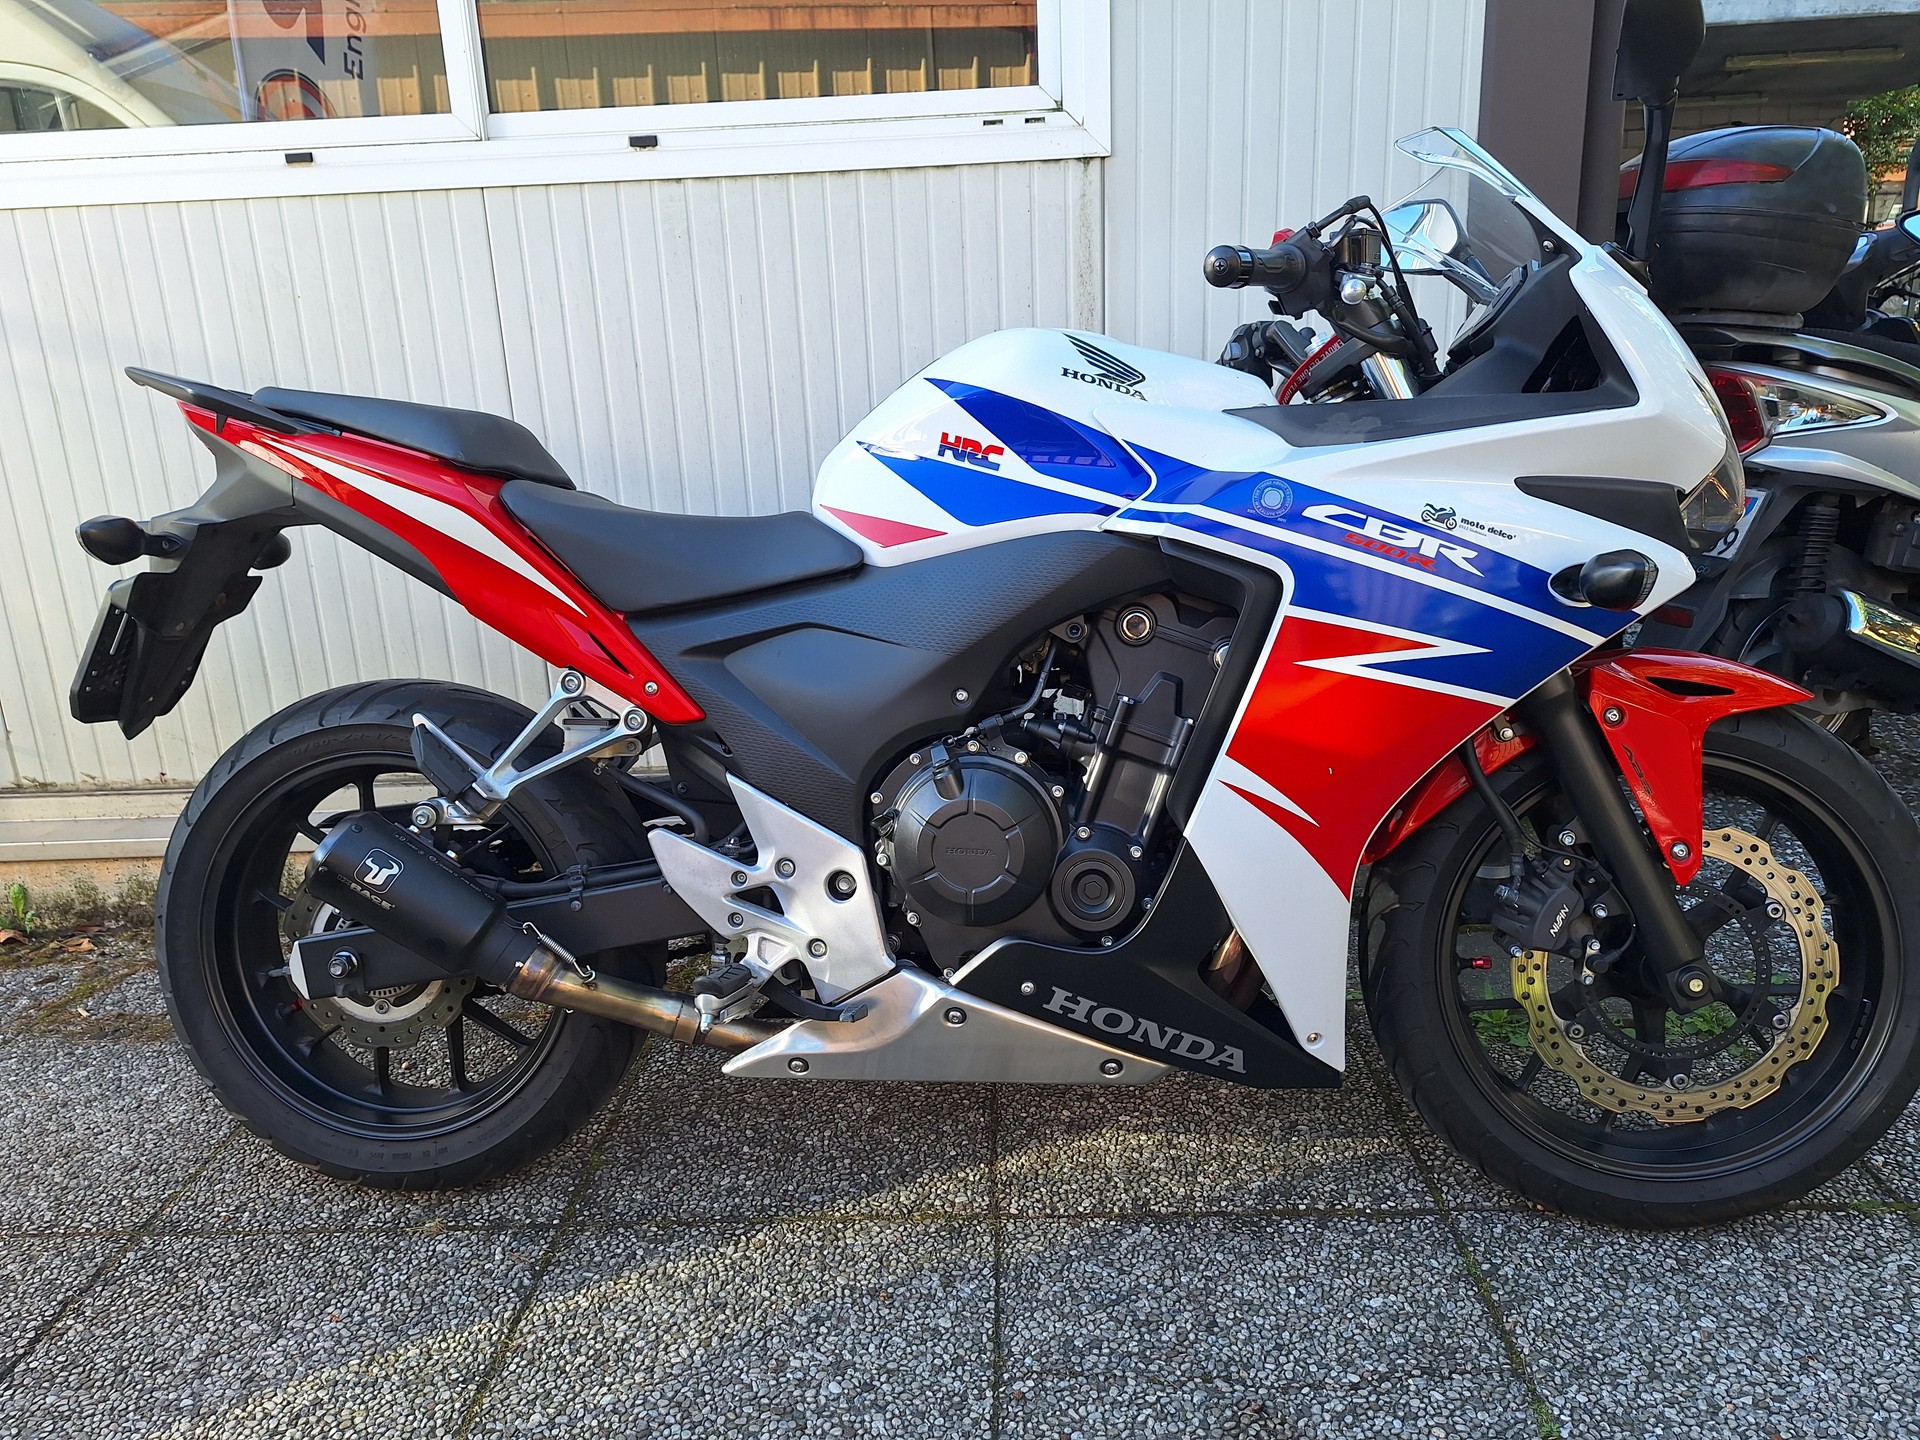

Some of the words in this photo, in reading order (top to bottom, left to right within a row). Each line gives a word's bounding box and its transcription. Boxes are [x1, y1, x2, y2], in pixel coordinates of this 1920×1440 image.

[1061, 367, 1148, 402] HONDA
[938, 432, 1005, 471] HRC
[1301, 504, 1486, 577] CBR
[1460, 517, 1486, 530] moto
[1717, 528, 1740, 556] 9
[1621, 743, 1653, 795] ABS
[945, 847, 997, 857] HONDA
[1549, 903, 1570, 938] NISSIN
[1042, 986, 1247, 1074] HONDA
